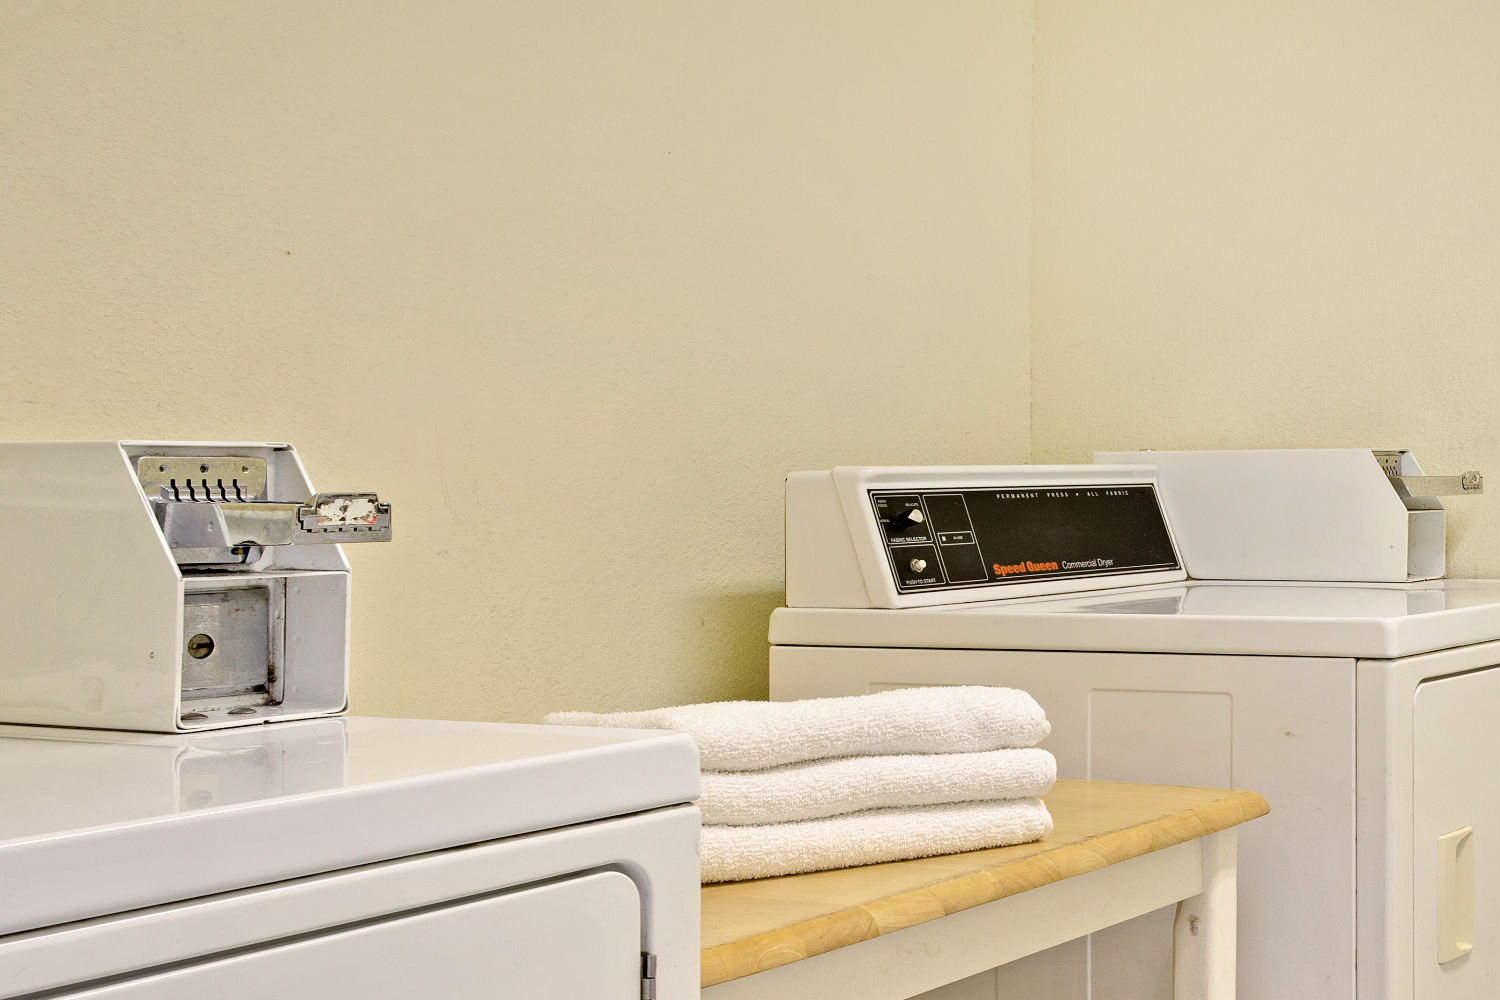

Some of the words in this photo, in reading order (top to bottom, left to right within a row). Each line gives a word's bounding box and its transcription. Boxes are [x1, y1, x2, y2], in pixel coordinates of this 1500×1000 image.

[996, 492, 1039, 500] PERMANENT
[993, 562, 1026, 576] Speed
[1027, 560, 1059, 573] Queen
[1061, 558, 1097, 570] Commercial
[1097, 558, 1114, 568] Dryer
